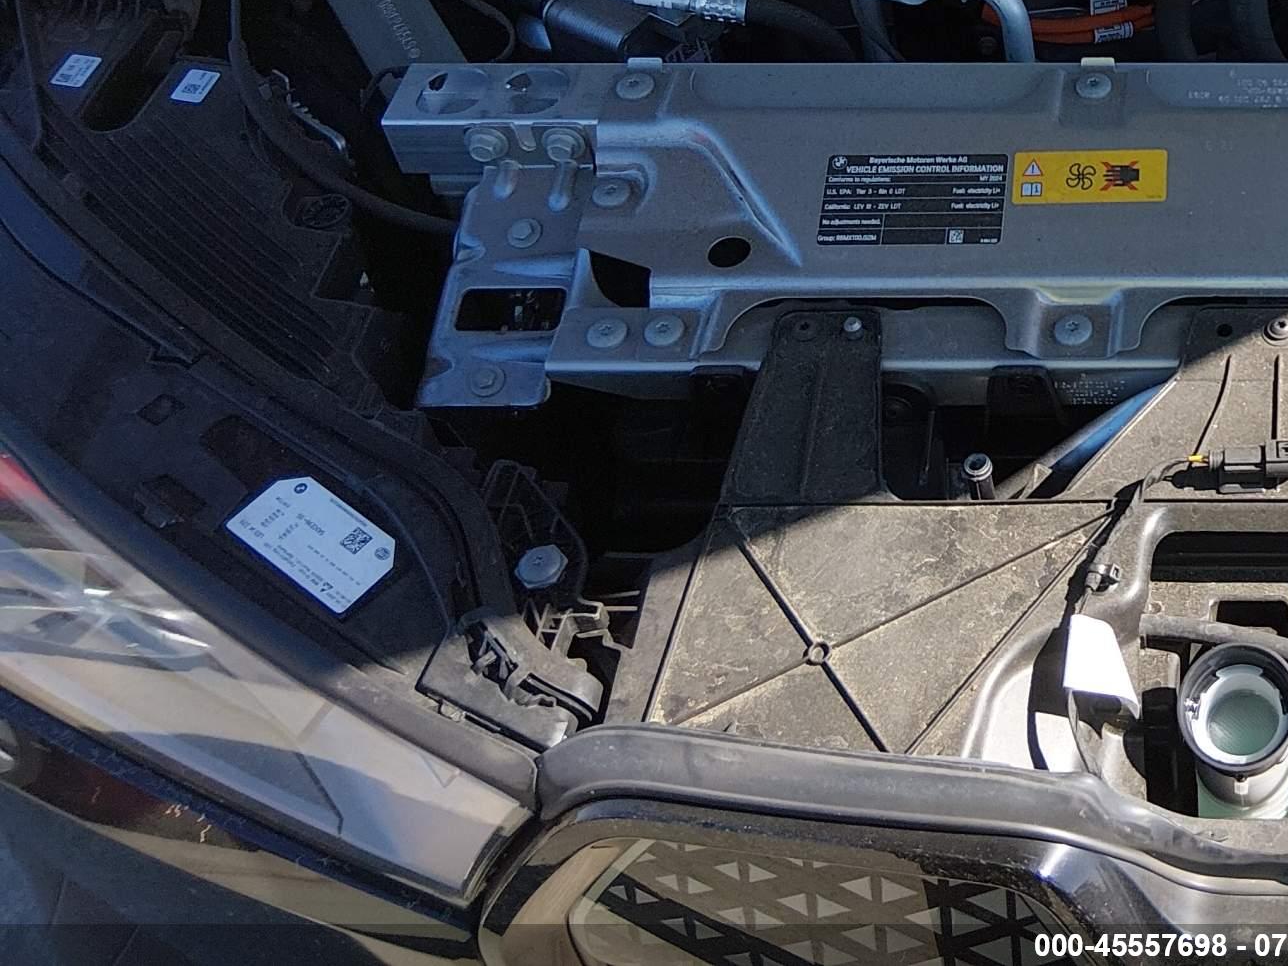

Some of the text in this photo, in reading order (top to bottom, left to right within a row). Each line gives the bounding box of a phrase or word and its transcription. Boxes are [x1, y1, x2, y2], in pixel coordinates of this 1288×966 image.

[869, 156, 906, 165] Bayerische
[846, 166, 876, 174] VEHICLE
[916, 165, 950, 173] CONTROL
[952, 164, 1004, 173] INFORMATION
[967, 188, 992, 196] electricity
